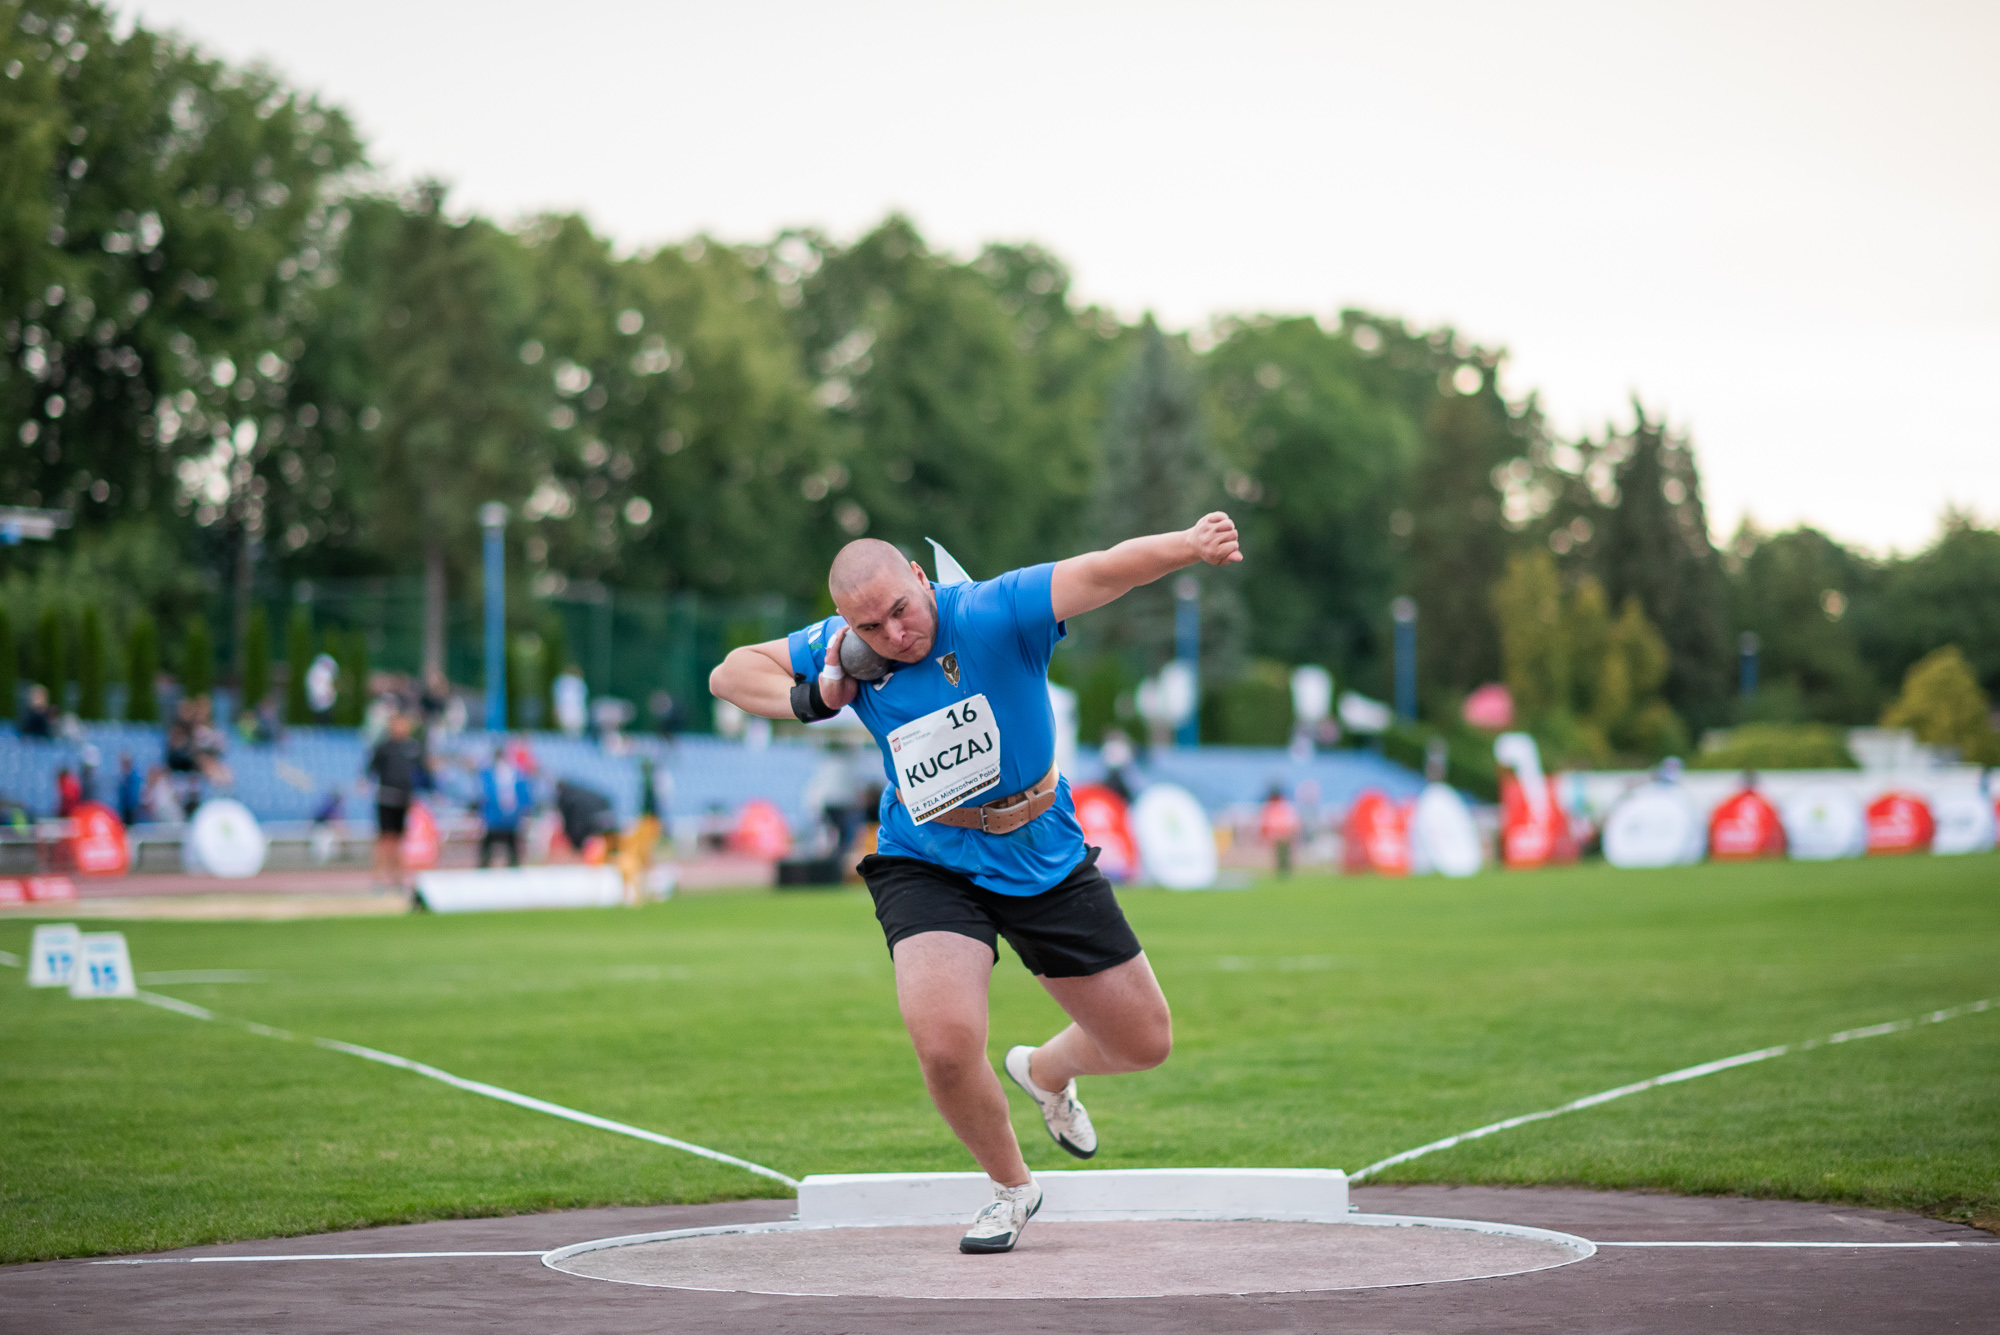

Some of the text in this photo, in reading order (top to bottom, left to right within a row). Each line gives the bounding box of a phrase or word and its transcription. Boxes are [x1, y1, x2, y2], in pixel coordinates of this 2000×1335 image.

[946, 702, 977, 730] 16
[905, 732, 993, 788] KUCZAJ
[923, 797, 940, 809] PZLA
[940, 777, 979, 800] Mistrzostwa
[88, 961, 119, 991] 15
